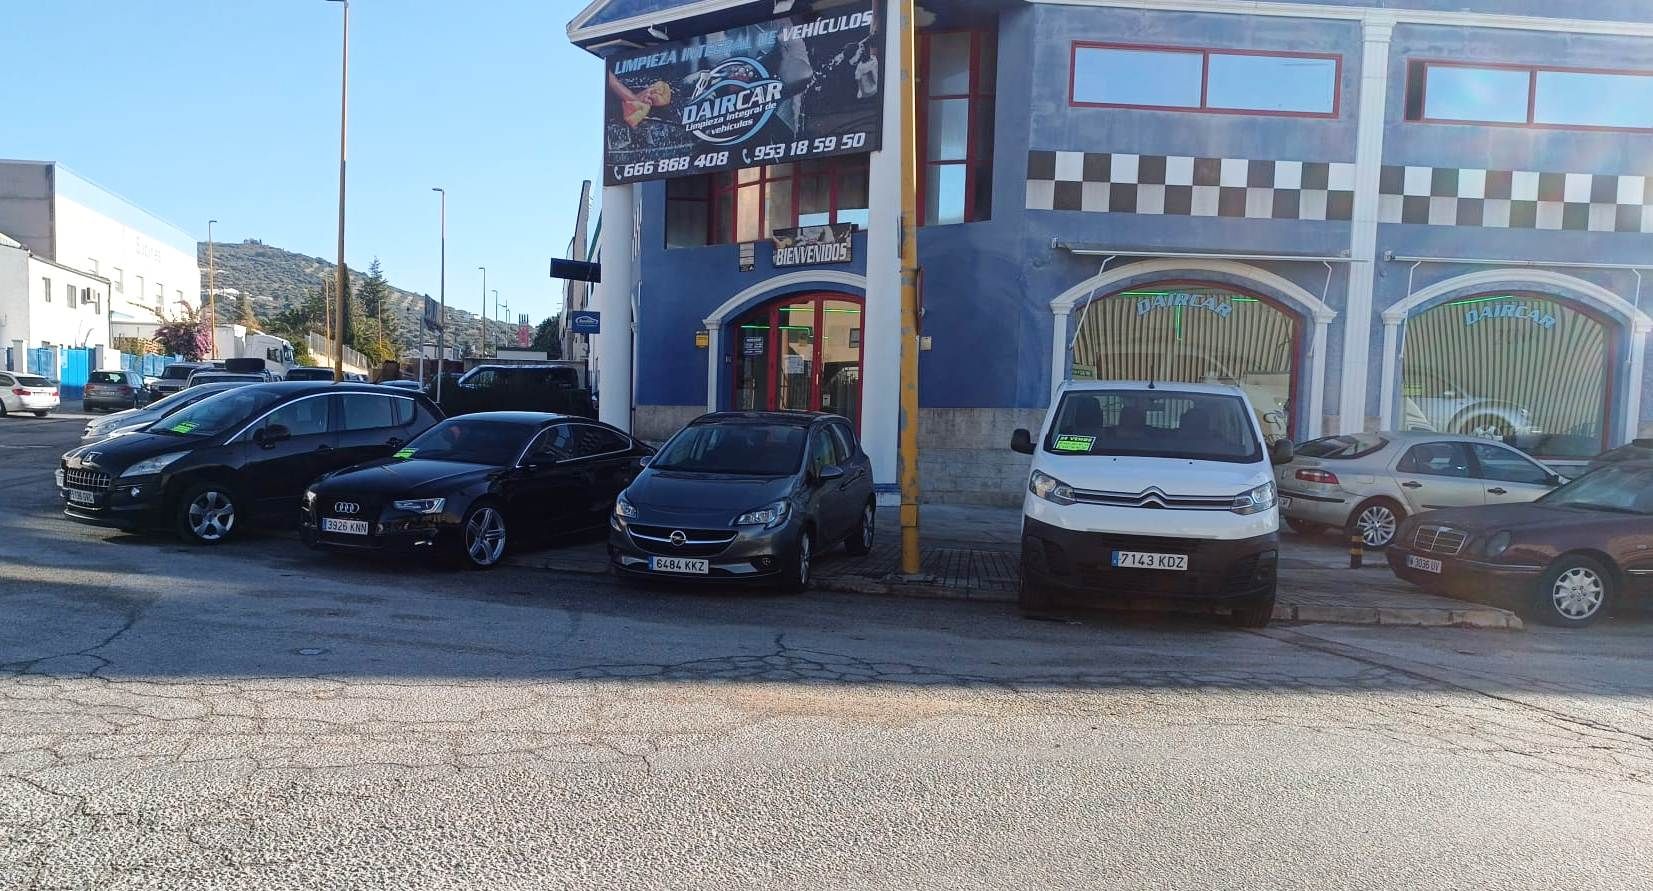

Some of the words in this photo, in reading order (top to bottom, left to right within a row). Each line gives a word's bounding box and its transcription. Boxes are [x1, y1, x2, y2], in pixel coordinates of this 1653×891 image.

[614, 50, 676, 75] LIMPIEZA
[682, 39, 752, 61] INTEGRAL
[758, 30, 777, 48] DE
[782, 10, 873, 41] VEHÍCULOS
[682, 82, 783, 125] DAIRCAR
[684, 116, 724, 132] Limpieza
[727, 107, 763, 121] integral
[765, 102, 777, 111] de
[753, 143, 786, 161] 953
[790, 139, 809, 156] 18
[813, 136, 837, 153] 59
[840, 132, 866, 149] 50
[624, 161, 655, 178] 666
[658, 155, 691, 173] 868
[694, 151, 729, 168] 408
[775, 242, 848, 266] BIENVENIDOS
[1136, 293, 1233, 319] DAIRCAR
[1465, 303, 1556, 329] DAIRCAR
[327, 520, 348, 531] 3926
[350, 522, 367, 533] KNN
[656, 558, 682, 570] 6484
[684, 560, 705, 572] KKZ
[1121, 553, 1154, 566] 7143
[1158, 555, 1185, 569] KDZ
